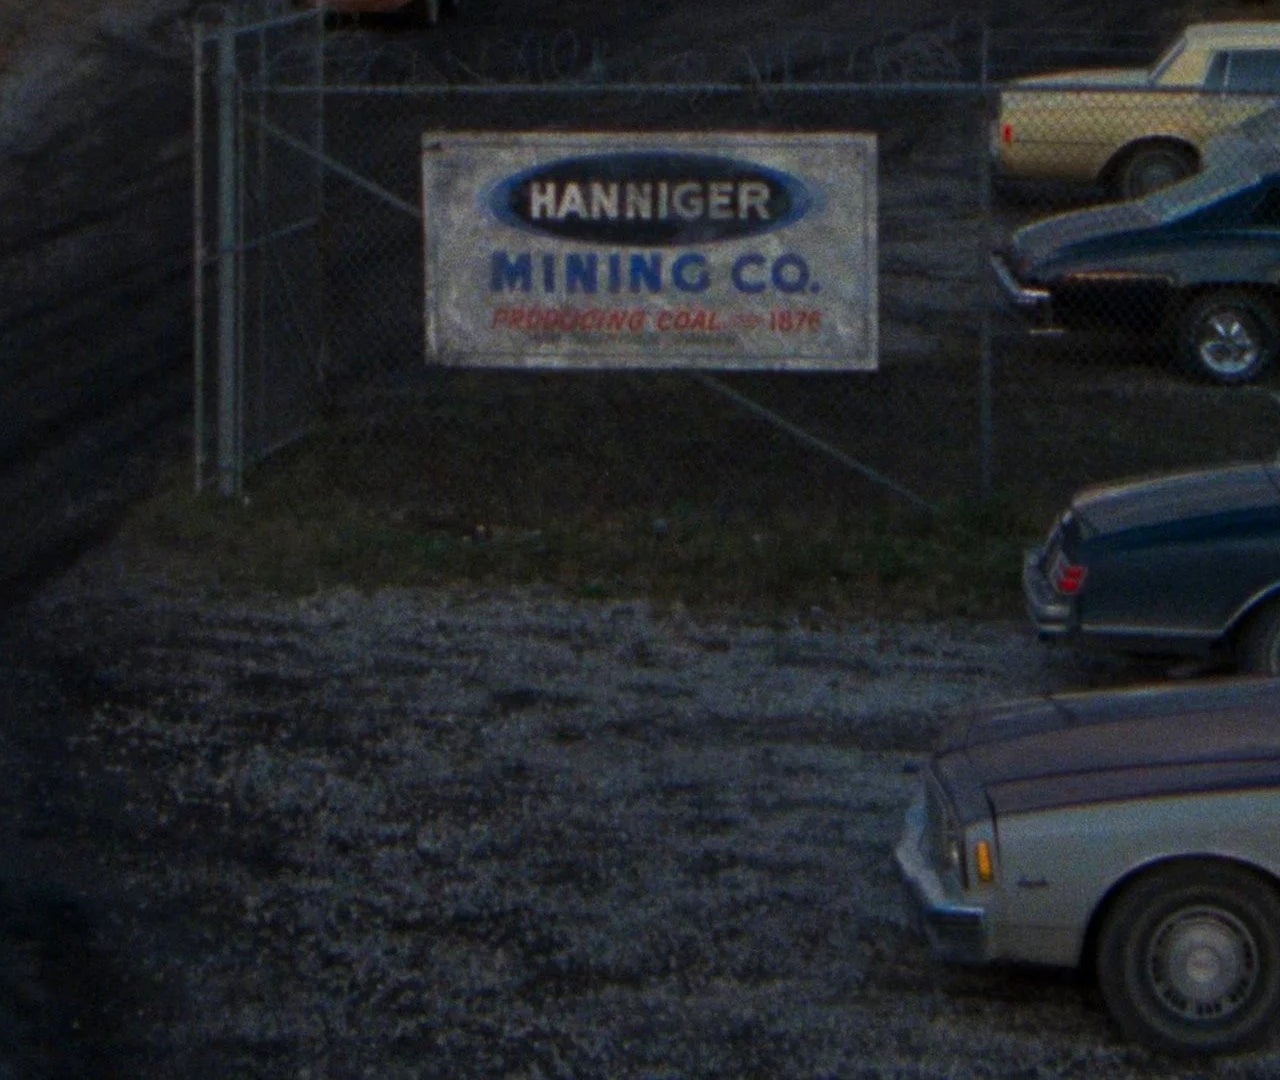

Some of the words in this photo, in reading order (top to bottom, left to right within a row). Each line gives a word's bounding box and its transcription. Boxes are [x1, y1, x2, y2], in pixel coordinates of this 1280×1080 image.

[529, 179, 772, 221] HANNIGER
[488, 251, 711, 294] MINING
[731, 252, 822, 295] CO.
[491, 308, 646, 333] PRODUCING
[656, 308, 720, 332] COAL
[769, 308, 823, 332] 1876
